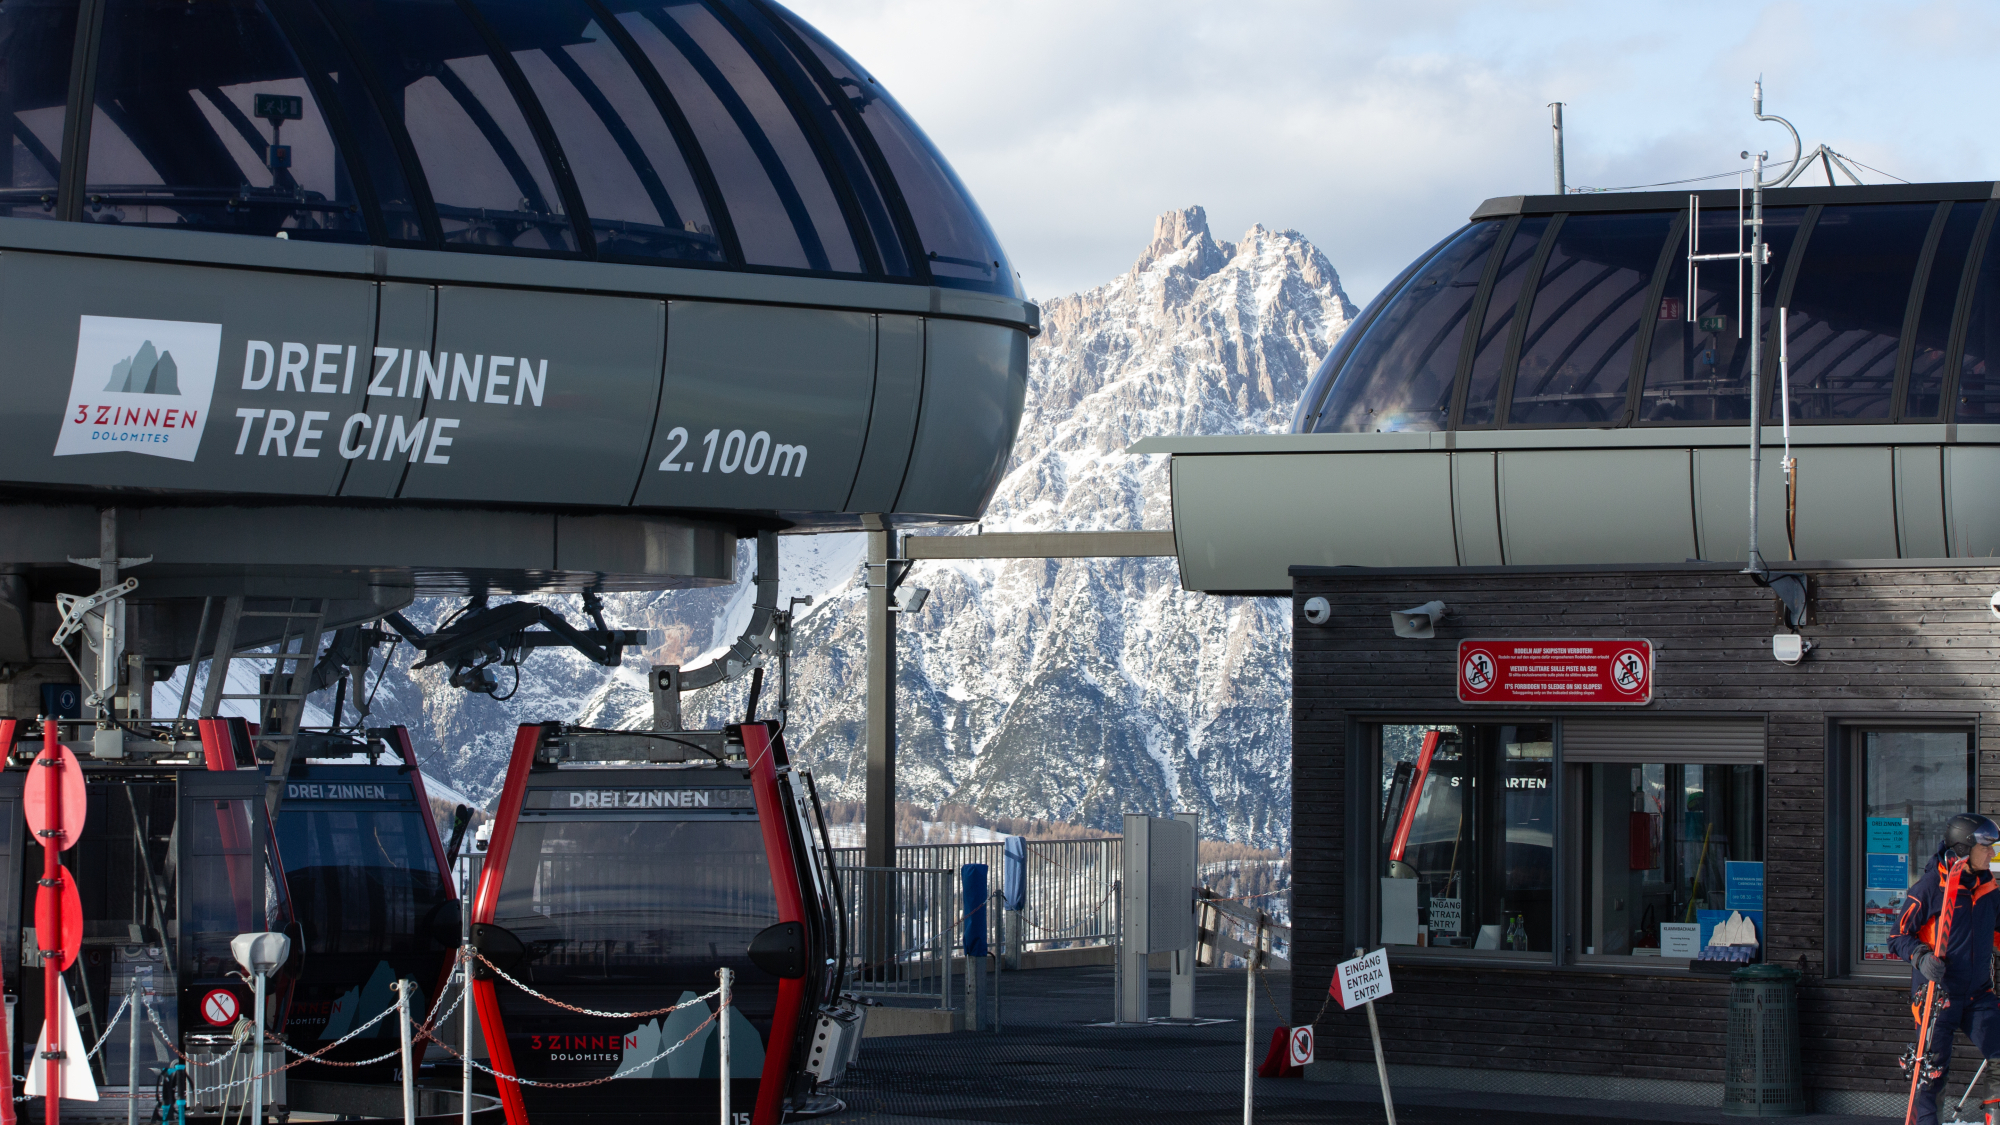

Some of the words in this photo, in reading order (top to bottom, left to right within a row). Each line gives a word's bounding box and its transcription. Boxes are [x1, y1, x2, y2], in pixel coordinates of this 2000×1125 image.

[241, 340, 357, 394] DREI
[366, 346, 548, 407] ZINNEN
[74, 404, 90, 425] 3
[93, 405, 198, 429] ZINNEN
[91, 431, 170, 443] DOLOMITES
[235, 407, 330, 458] TRE
[338, 412, 461, 465] CIME
[658, 426, 808, 477] 2.100m
[288, 784, 324, 798] DREI
[327, 784, 385, 799] ZINNEN
[569, 792, 620, 807] DREI
[626, 791, 709, 807] ZINNEN
[1430, 901, 1461, 910] INGANG
[1430, 910, 1460, 918] NTRATA
[1430, 920, 1456, 928] ENTRY
[1345, 955, 1381, 976] EINGANG
[1347, 968, 1384, 990] ENTRATA
[1354, 982, 1380, 1001] ENTRY
[290, 1001, 342, 1014] INNEN
[531, 1035, 542, 1050] 3
[548, 1035, 637, 1050] ZINNEN
[550, 1053, 619, 1061] DOLOMITES
